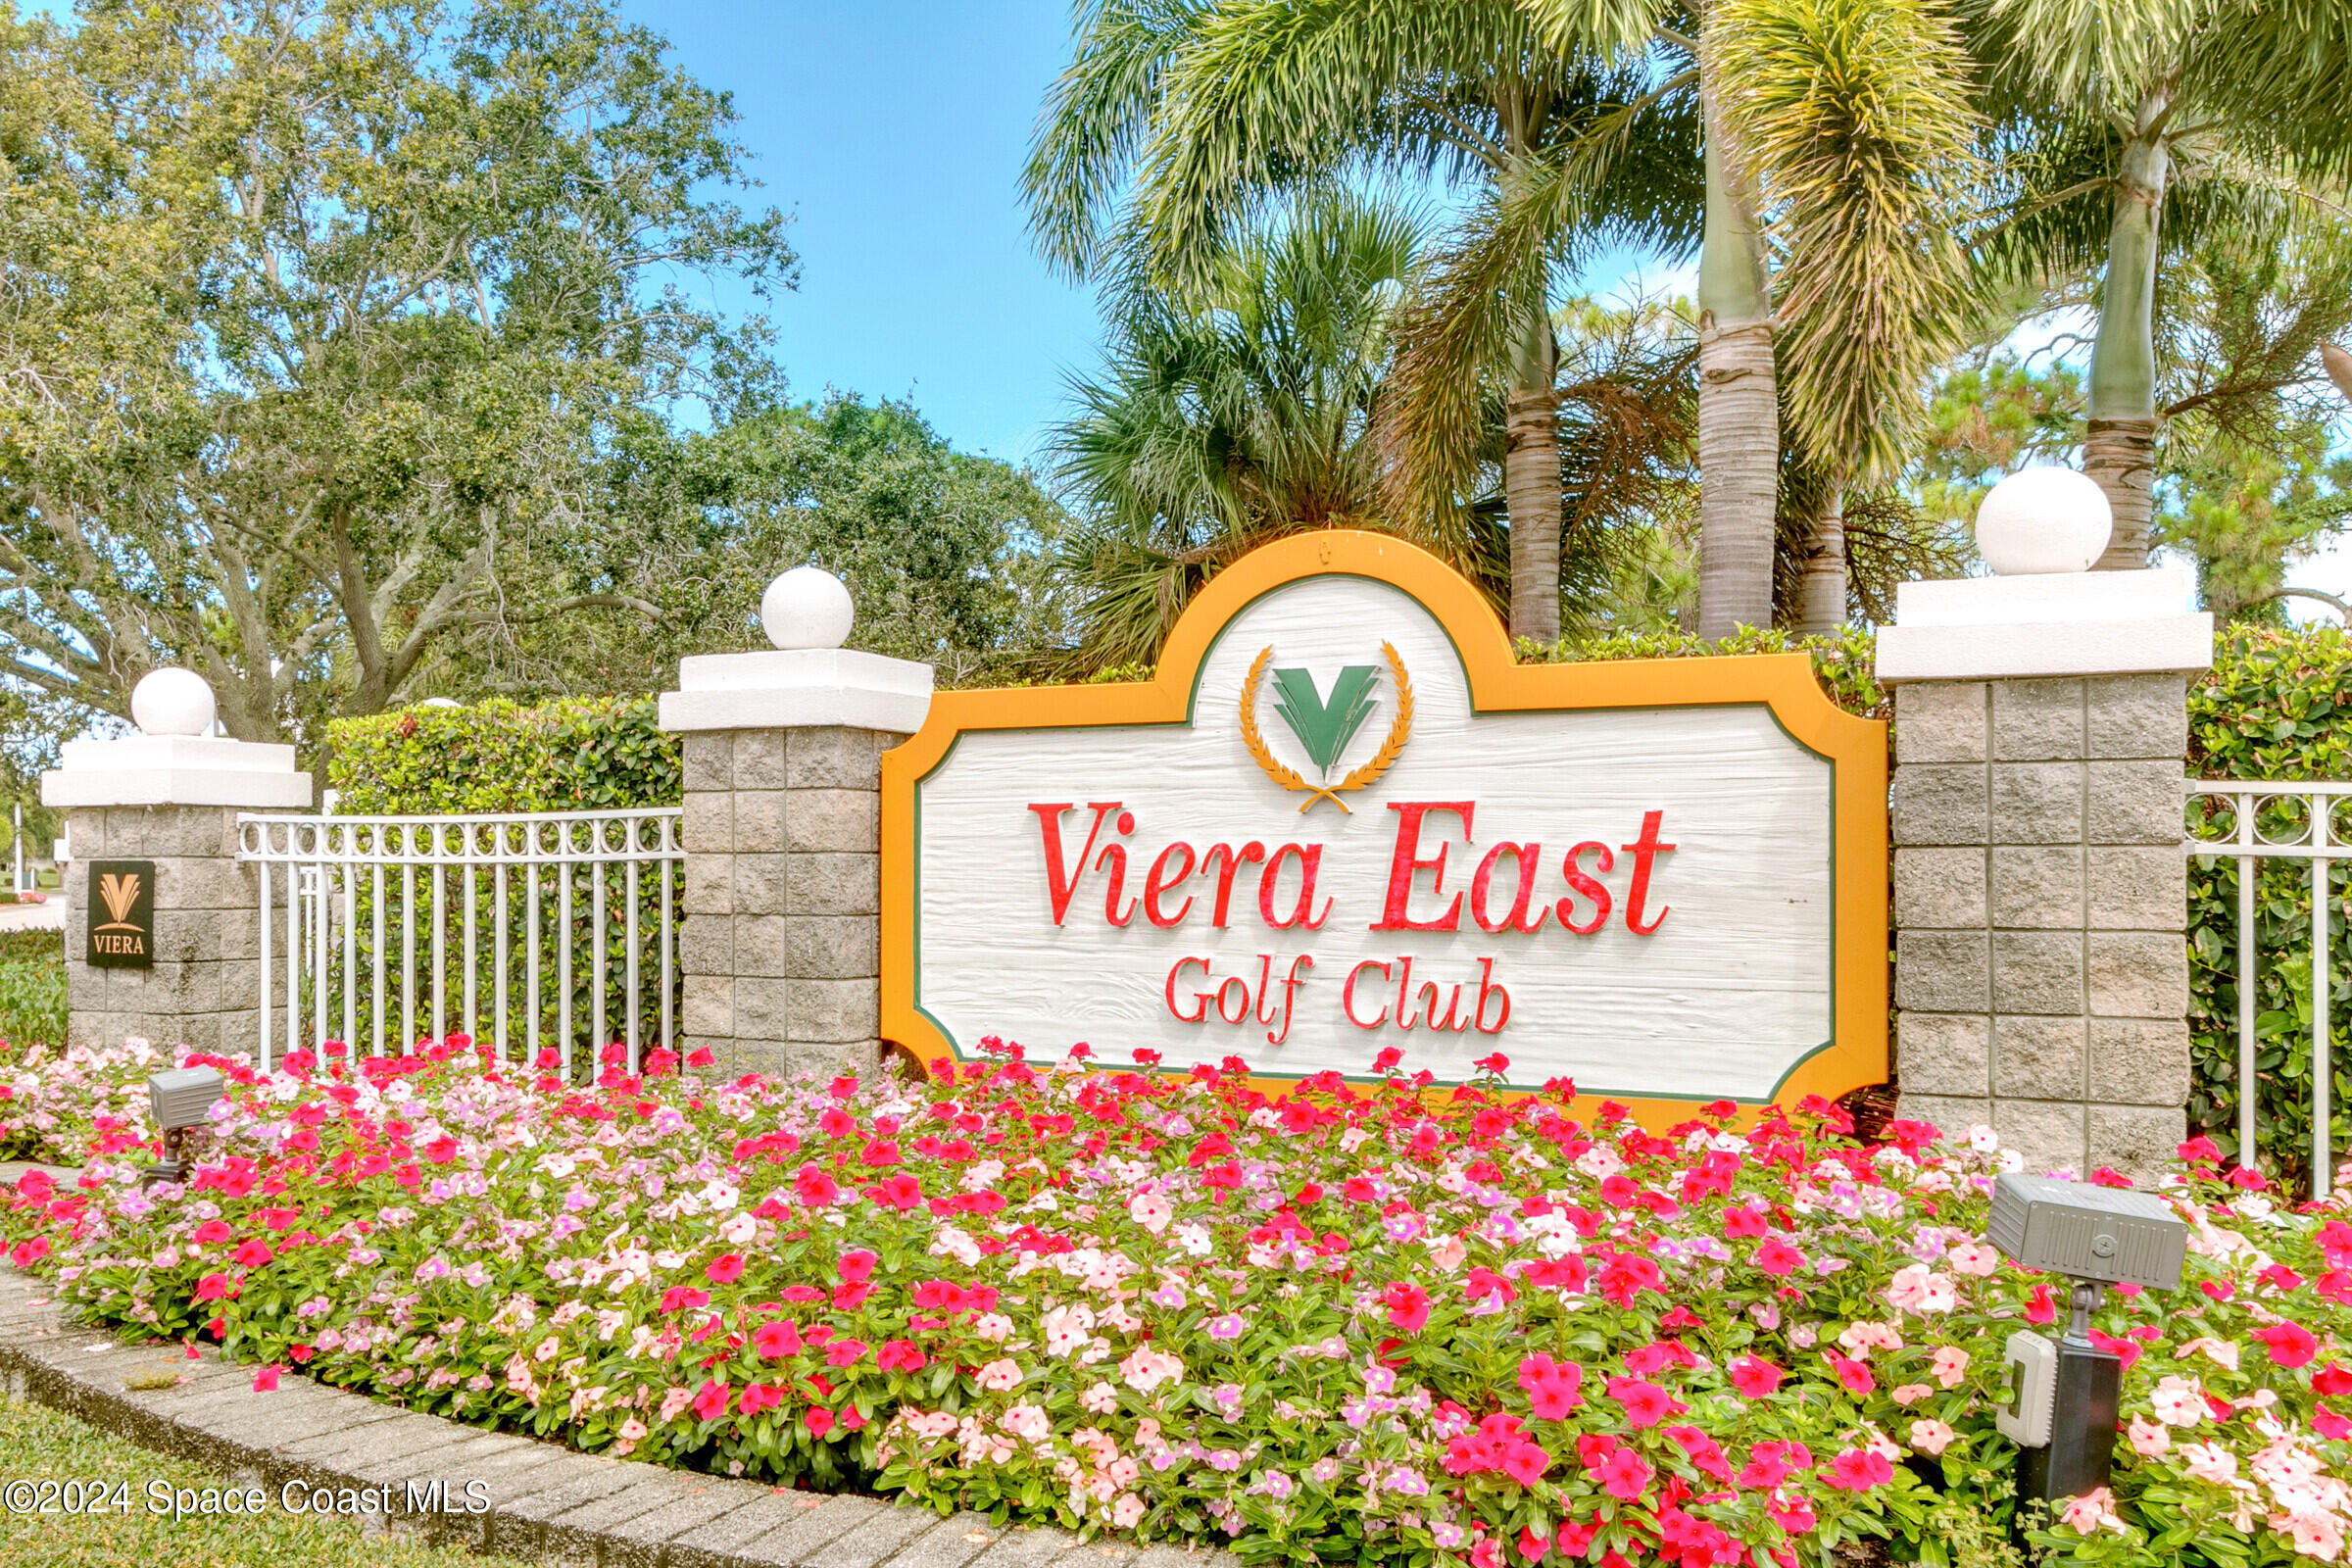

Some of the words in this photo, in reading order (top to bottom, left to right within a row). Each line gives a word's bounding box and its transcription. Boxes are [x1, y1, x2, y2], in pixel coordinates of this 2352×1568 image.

[1027, 800, 1334, 930] Viera
[1369, 799, 1677, 936] East
[93, 935, 144, 955] VIERA
[1165, 954, 1314, 1045] Golf
[1344, 956, 1511, 1034] Club
